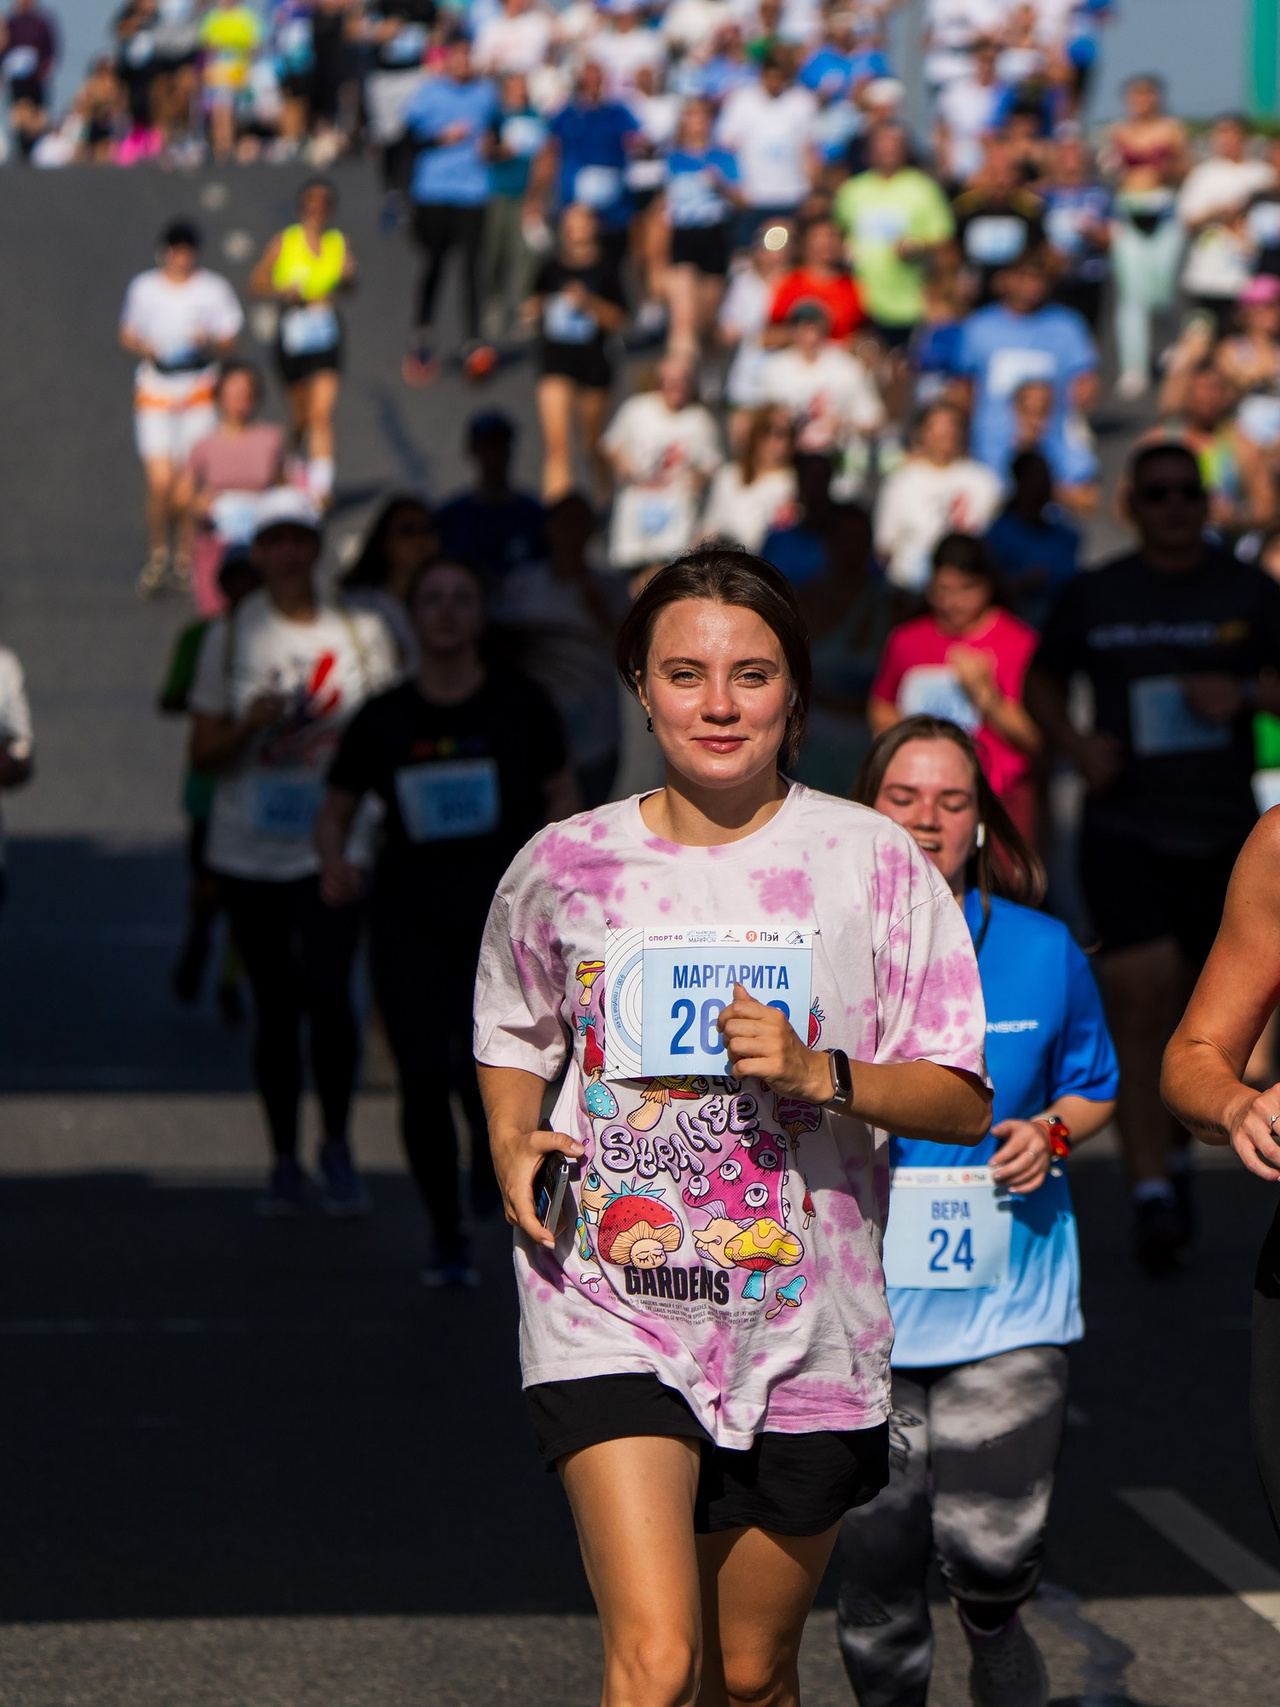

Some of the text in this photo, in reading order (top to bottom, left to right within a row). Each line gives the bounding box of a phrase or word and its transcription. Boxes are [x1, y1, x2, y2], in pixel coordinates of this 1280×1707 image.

[648, 934, 673, 942] СПОРТ
[760, 931, 779, 942] Пэй
[673, 965, 790, 990] МАРГАРИТА
[670, 998, 791, 1056] 26
[931, 1200, 971, 1220] ВЕРА
[929, 1228, 975, 1273] 24
[623, 1266, 730, 1305] GARDENS
